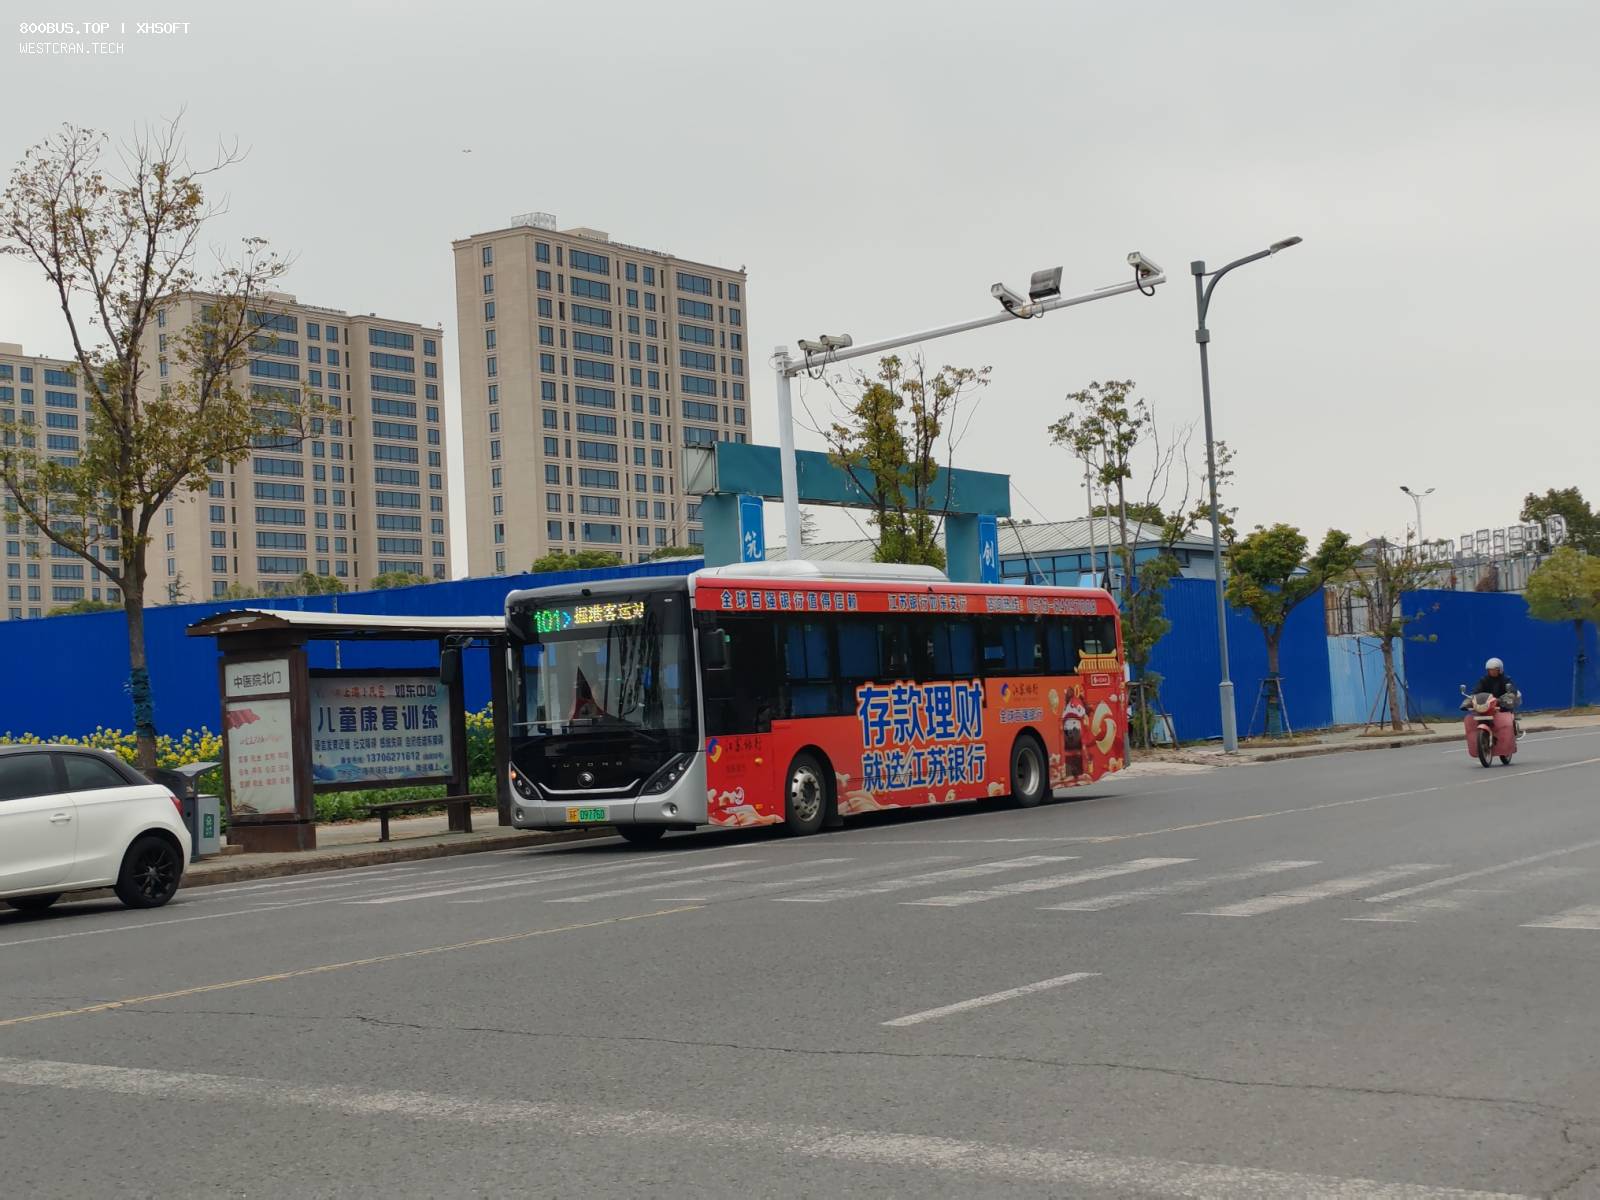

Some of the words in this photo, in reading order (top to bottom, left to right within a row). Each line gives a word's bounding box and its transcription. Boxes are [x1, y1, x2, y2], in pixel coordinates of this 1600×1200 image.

[720, 588, 858, 612] 全球百强银行值得信赖
[534, 609, 560, 633] 101
[233, 671, 282, 688] 中医院北门
[317, 703, 439, 733] 儿童康复训练
[857, 680, 985, 749] 存款理财
[862, 744, 987, 793] 就选江苏银行
